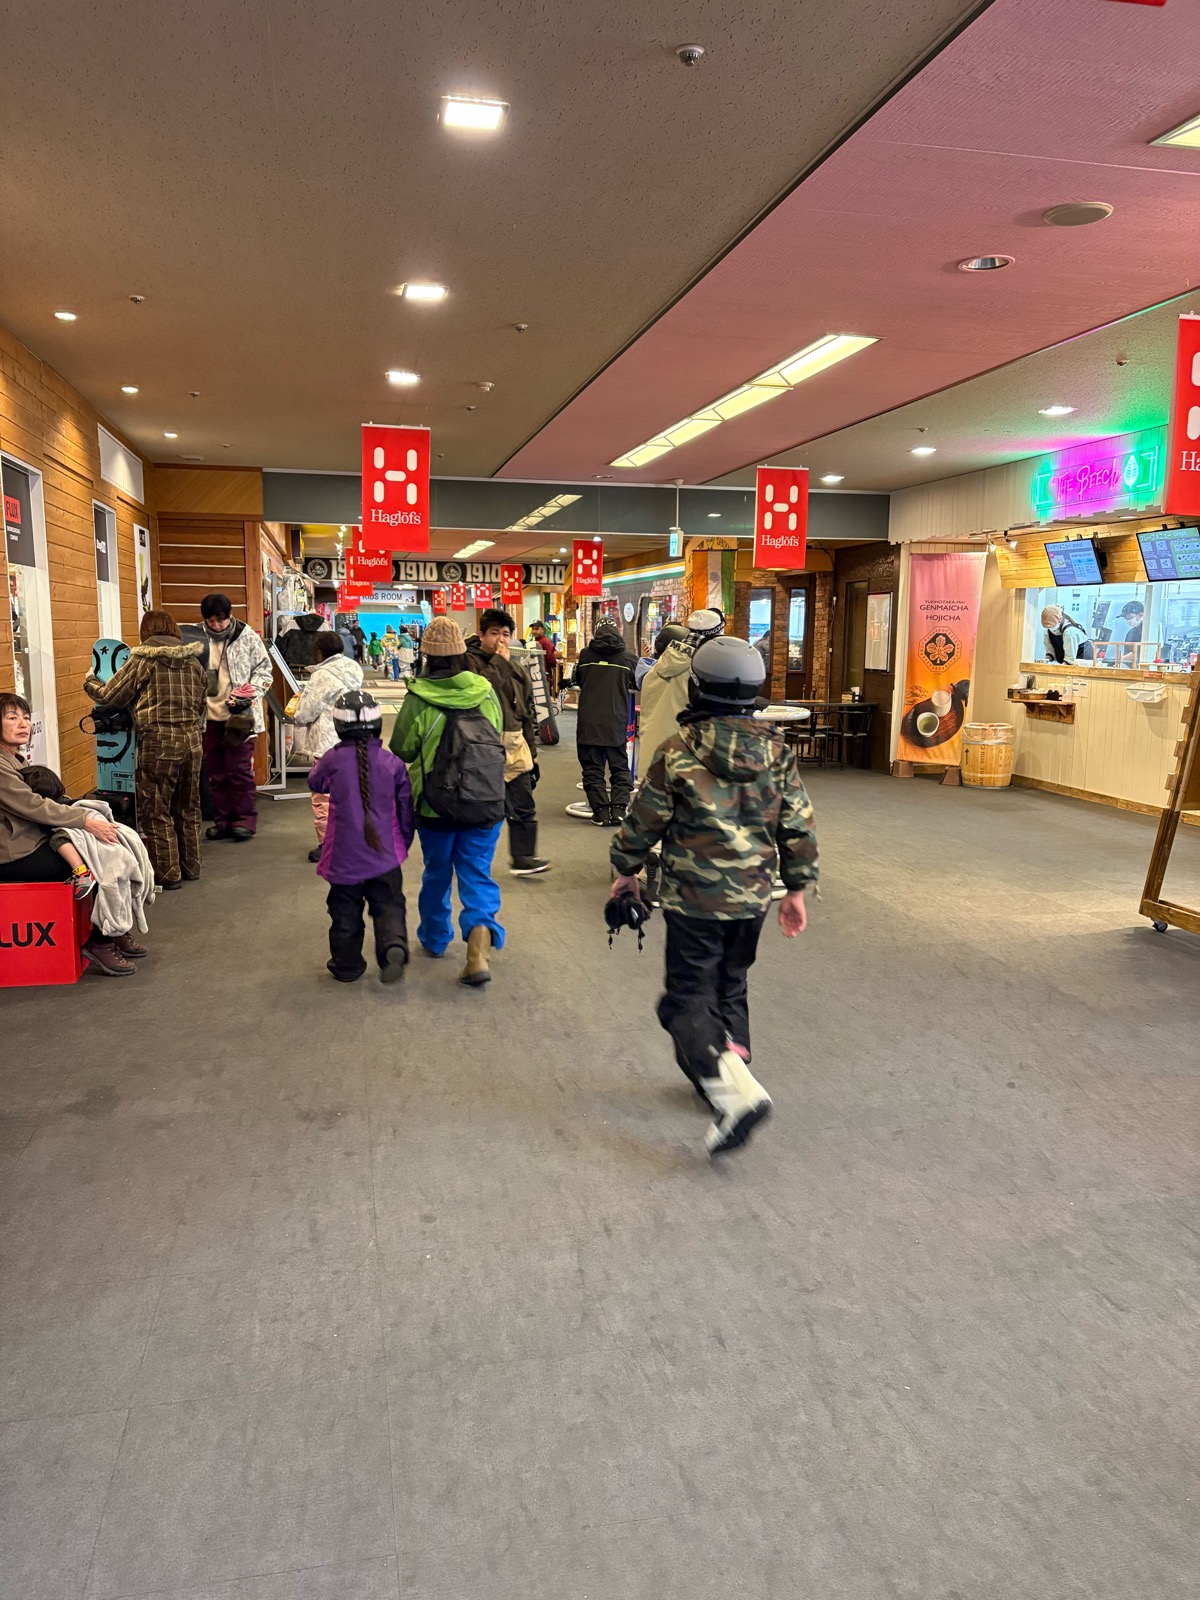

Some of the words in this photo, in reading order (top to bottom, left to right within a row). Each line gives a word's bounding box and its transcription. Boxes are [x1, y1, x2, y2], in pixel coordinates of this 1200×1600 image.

[1050, 471, 1074, 502] THE
[6, 500, 19, 519] FLUX
[370, 509, 421, 526] Haglöfs
[761, 535, 799, 548] Haglöfs
[357, 556, 388, 567] Haglöfs
[398, 561, 438, 581] 1910
[464, 563, 501, 583] 1910
[529, 565, 566, 584] 1910
[381, 593, 402, 601] ROOM
[925, 614, 961, 622] HOJICHA
